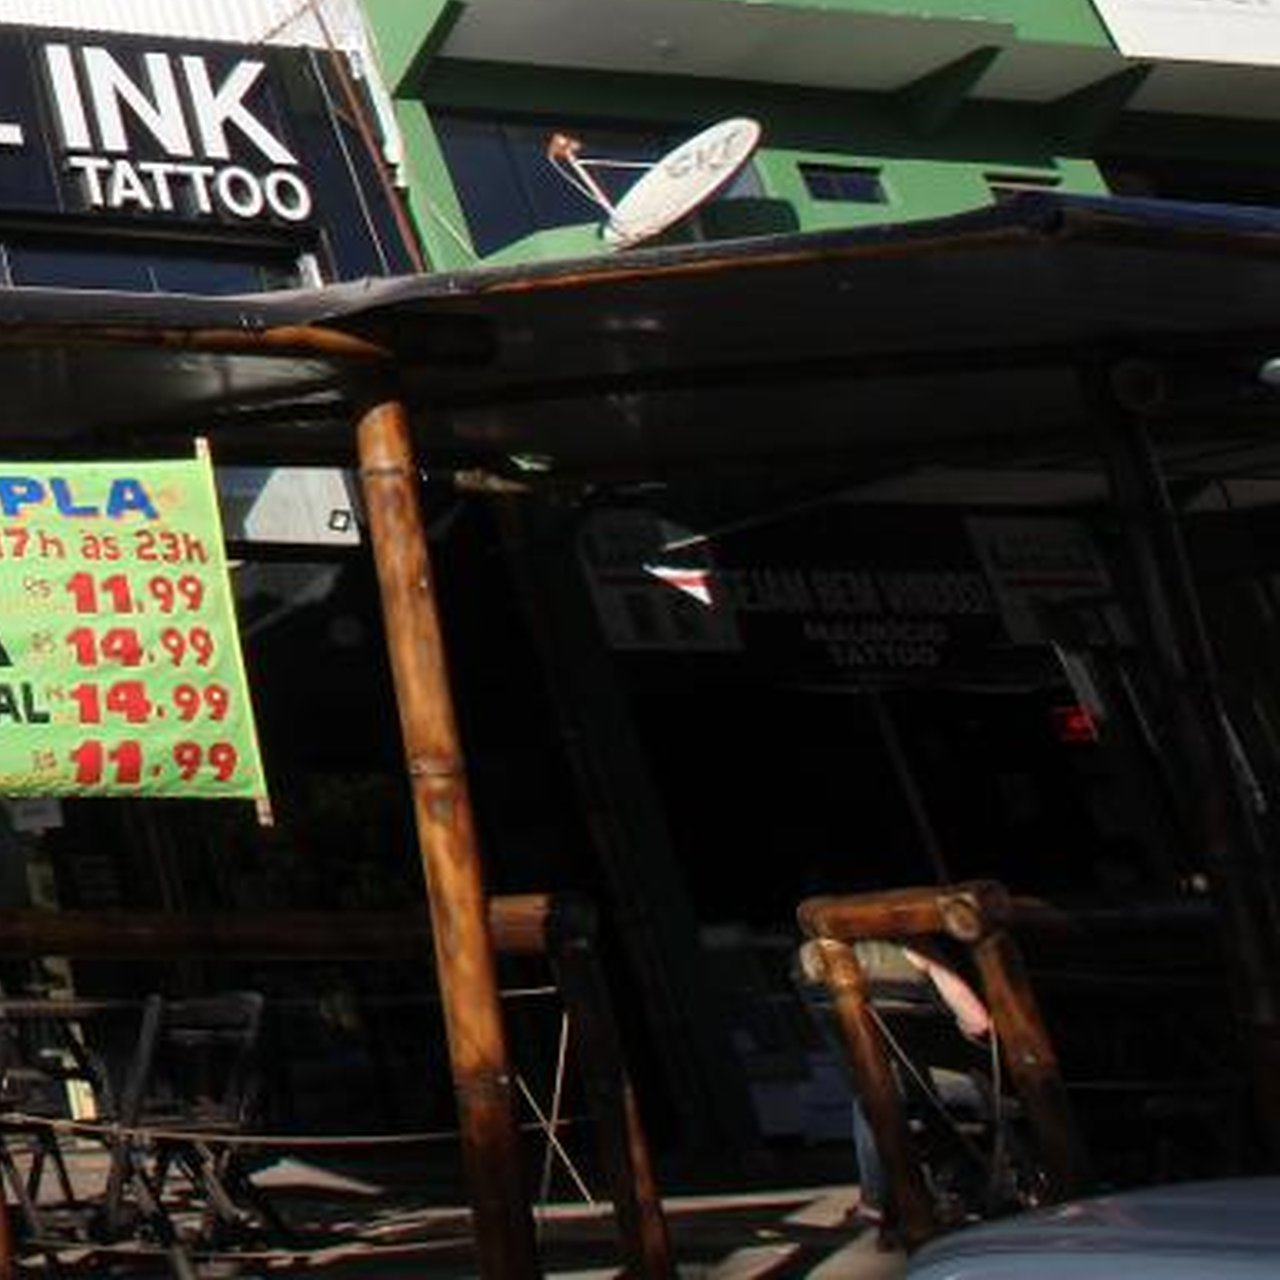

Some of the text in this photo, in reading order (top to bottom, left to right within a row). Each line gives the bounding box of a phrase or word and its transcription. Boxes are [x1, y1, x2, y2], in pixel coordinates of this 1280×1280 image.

[44, 43, 300, 166] INK
[66, 155, 312, 221] TATTOO
[133, 528, 209, 565] 23h
[65, 571, 205, 614] 11.99
[65, 626, 215, 667] 14.99
[69, 679, 230, 725] 14.99
[69, 738, 239, 786] 11.99
